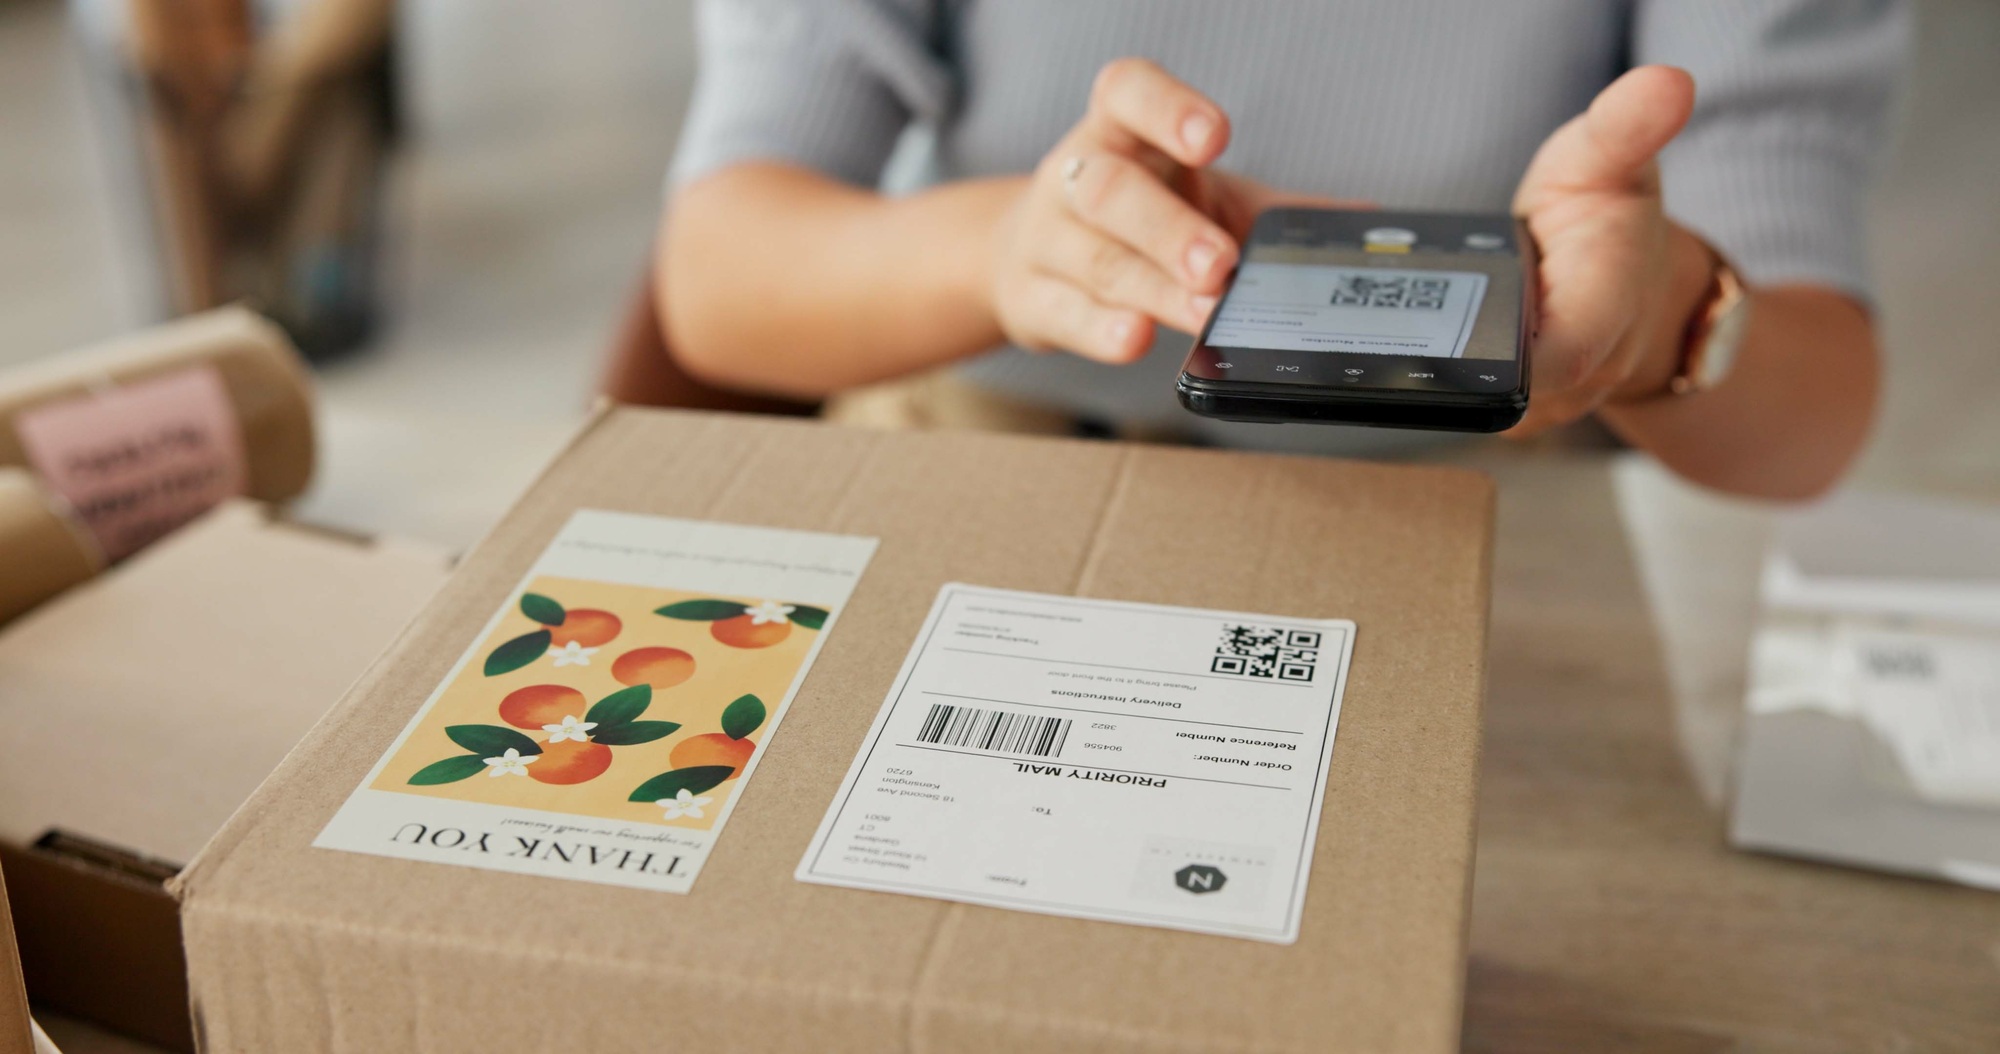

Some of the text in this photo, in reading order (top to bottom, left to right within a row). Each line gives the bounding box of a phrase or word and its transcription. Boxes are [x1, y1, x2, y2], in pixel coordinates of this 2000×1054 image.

[996, 634, 1039, 646] Tracking
[1047, 670, 1070, 679] door
[1072, 672, 1095, 681] front
[1136, 678, 1160, 688] bring
[1162, 682, 1198, 691] Please
[1050, 689, 1182, 710] Delivery Instructions
[1090, 722, 1118, 731] 3822
[1082, 742, 1124, 752] 904556
[1229, 737, 1297, 750] Reference
[1192, 754, 1292, 771] Order Number:
[886, 767, 914, 776] 6720
[1012, 762, 1168, 788] PRIORITY MAIL
[882, 776, 940, 790] Kensington
[876, 786, 898, 796] Ave
[899, 790, 940, 801] Second
[1030, 806, 1052, 815] To:
[554, 824, 589, 836] small
[614, 828, 677, 845] supporting
[388, 823, 687, 878] THANK YOU
[1188, 872, 1214, 889] N
